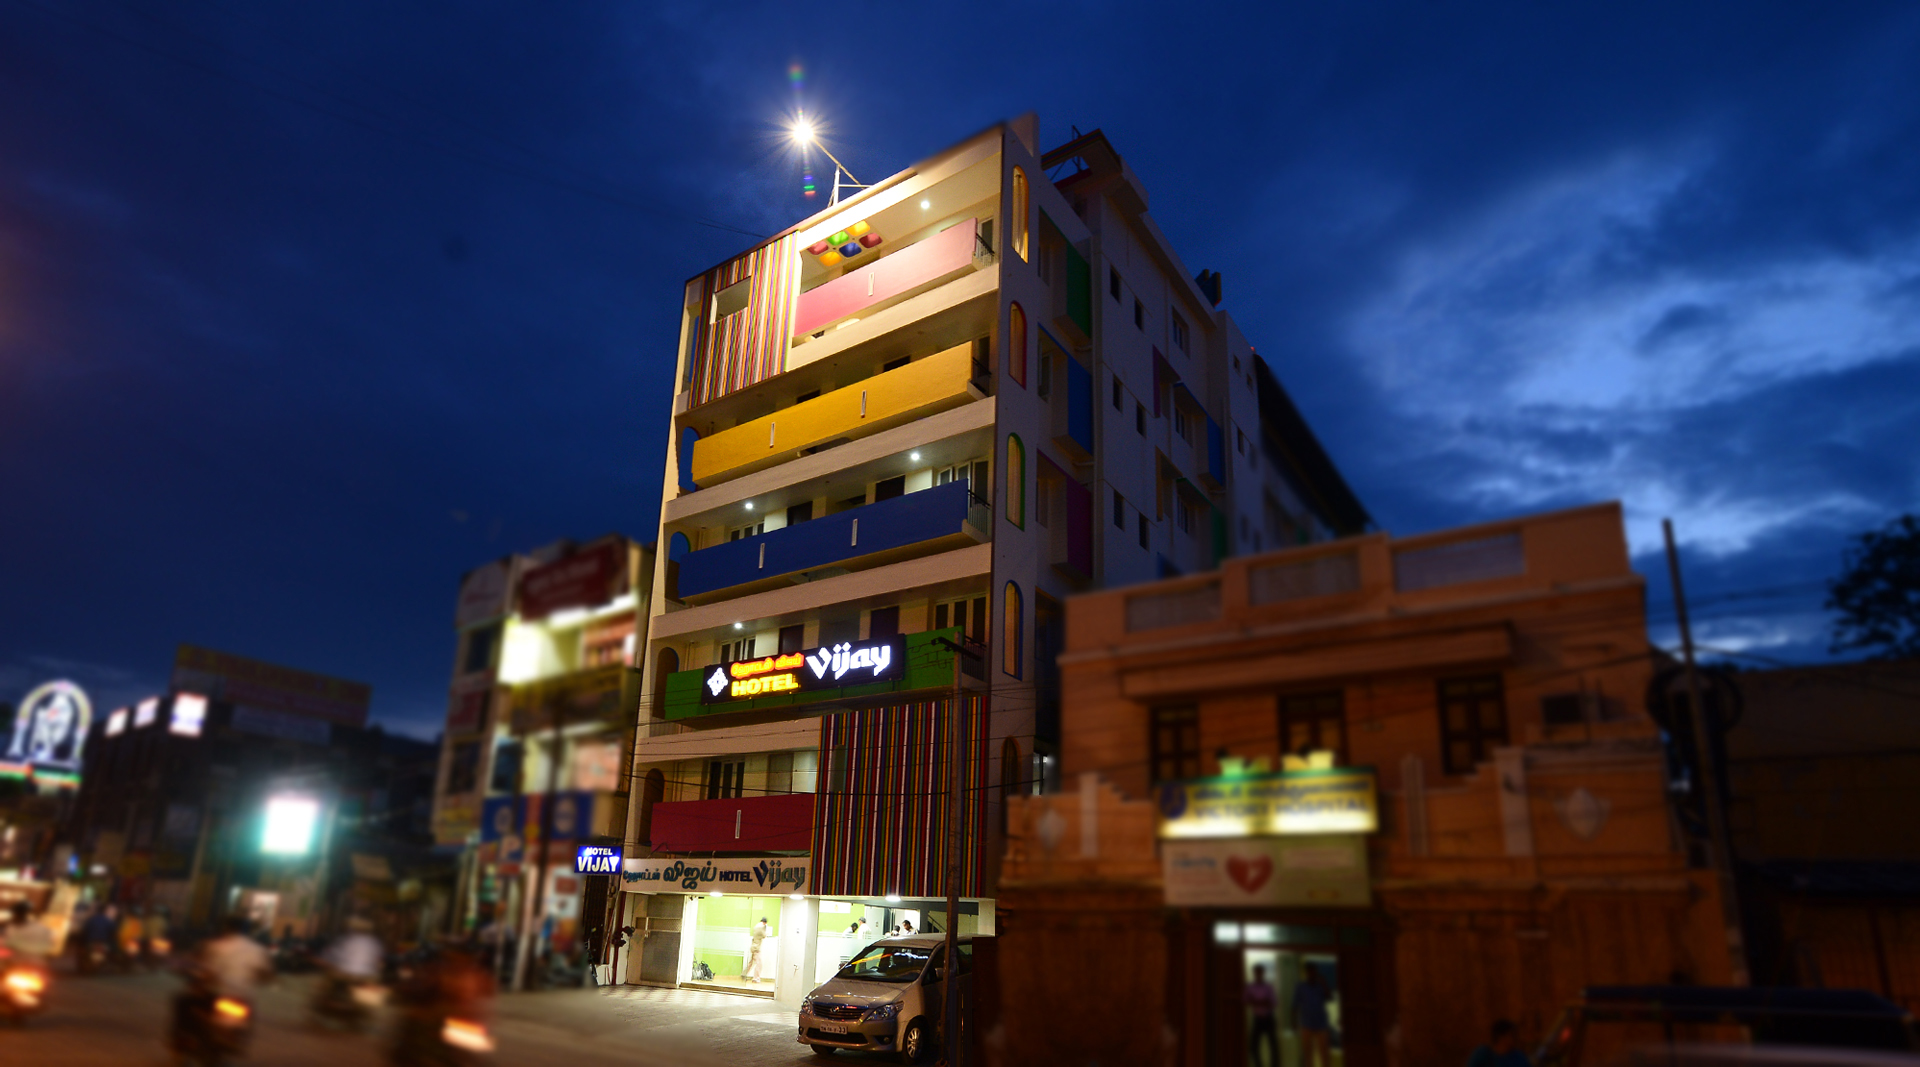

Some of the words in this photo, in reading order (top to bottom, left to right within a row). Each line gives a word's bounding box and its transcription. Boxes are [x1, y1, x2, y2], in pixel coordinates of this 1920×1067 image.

[731, 673, 799, 697] HOTEL
[805, 641, 891, 680] Vijay
[577, 856, 620, 872] VIJAY
[663, 860, 717, 890] விஜய்
[718, 870, 753, 882] HOTEL
[752, 860, 806, 890] Vijay
